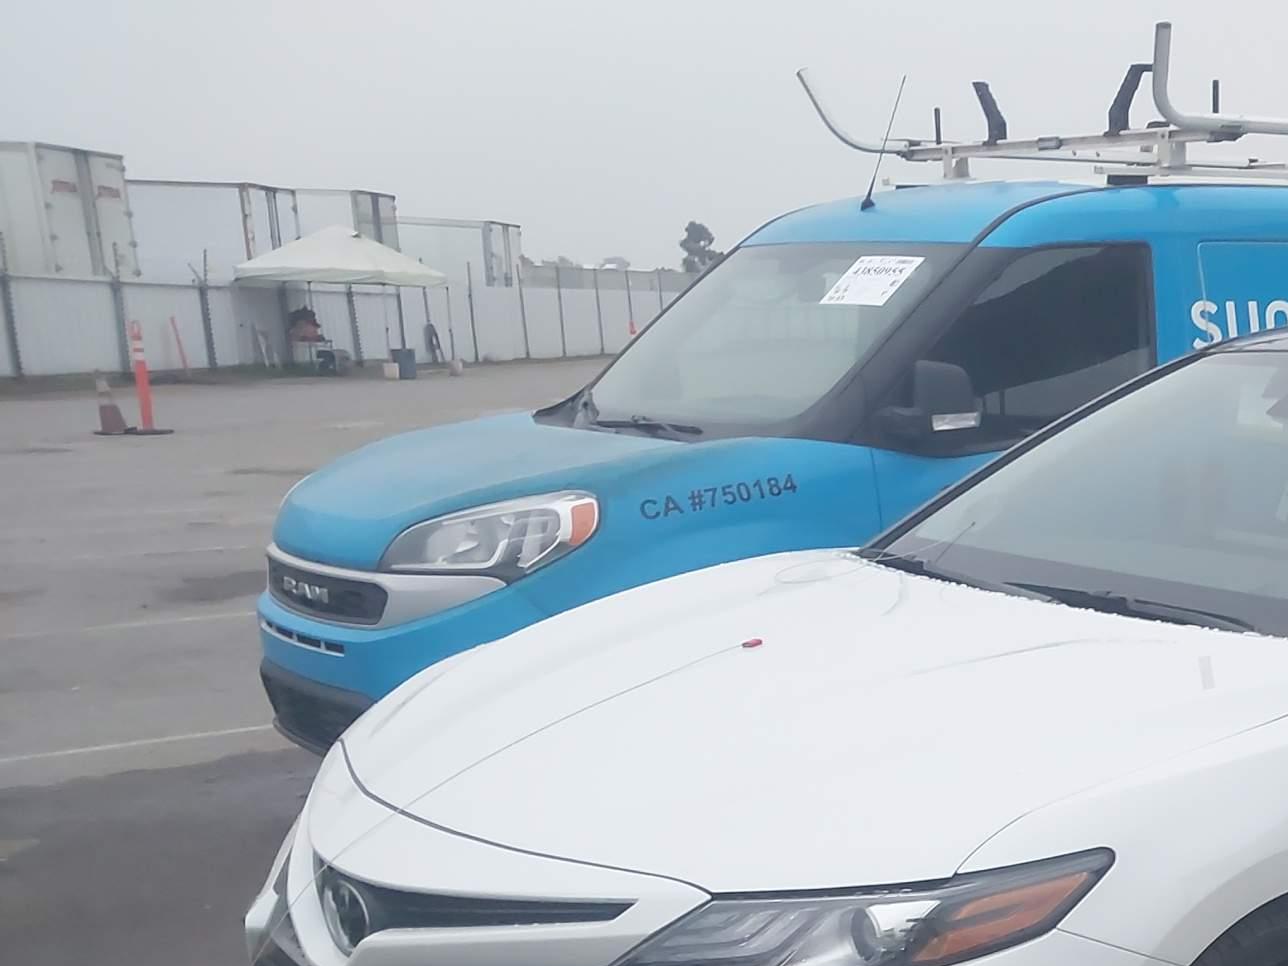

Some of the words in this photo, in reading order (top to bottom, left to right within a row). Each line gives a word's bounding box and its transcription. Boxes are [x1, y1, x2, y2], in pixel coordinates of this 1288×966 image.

[639, 495, 685, 520] CA
[688, 474, 798, 512] #750184
[283, 576, 329, 604] RAM
